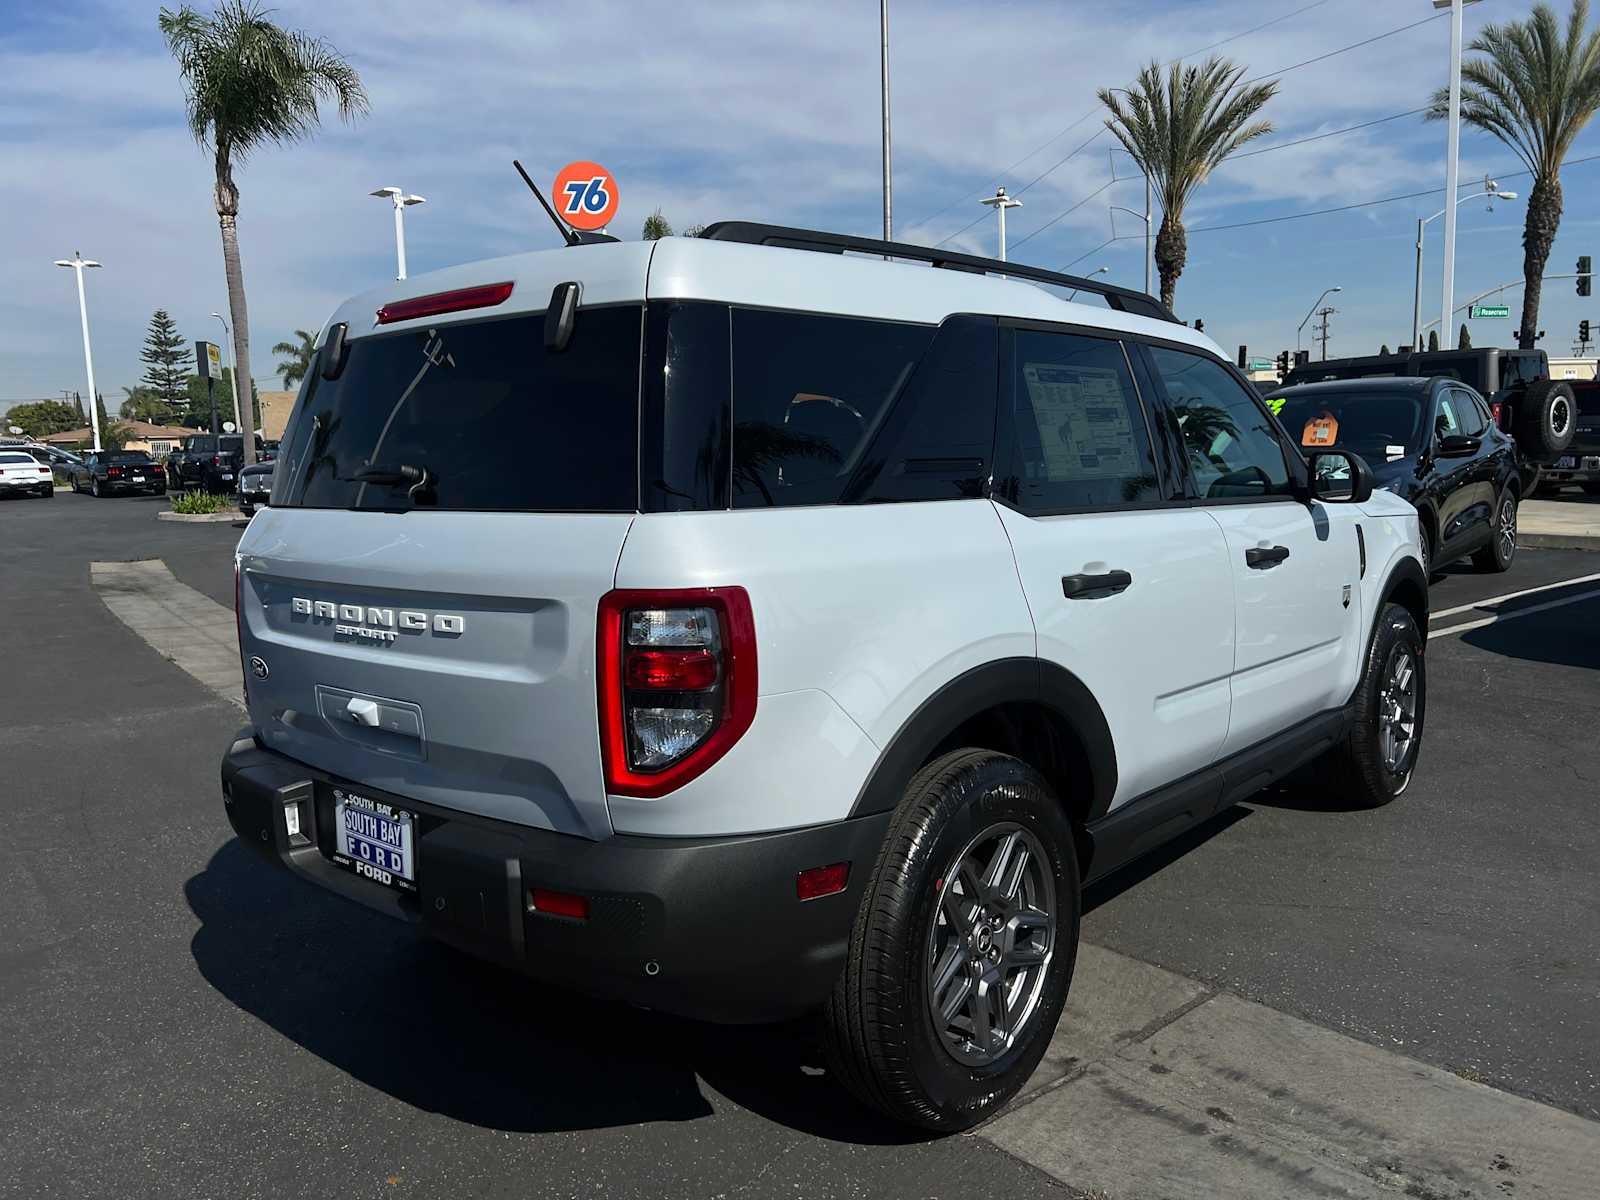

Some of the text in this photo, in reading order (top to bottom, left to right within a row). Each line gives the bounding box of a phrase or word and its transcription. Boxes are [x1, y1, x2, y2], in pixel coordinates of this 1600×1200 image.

[562, 176, 609, 215] 76
[291, 597, 464, 633] BRONCO
[335, 624, 399, 641] SPORT
[348, 794, 374, 811] SOUTH
[377, 803, 392, 816] BAY
[345, 809, 401, 846] SOUTH BAY
[348, 837, 401, 872] FORD
[356, 861, 392, 885] FORD
